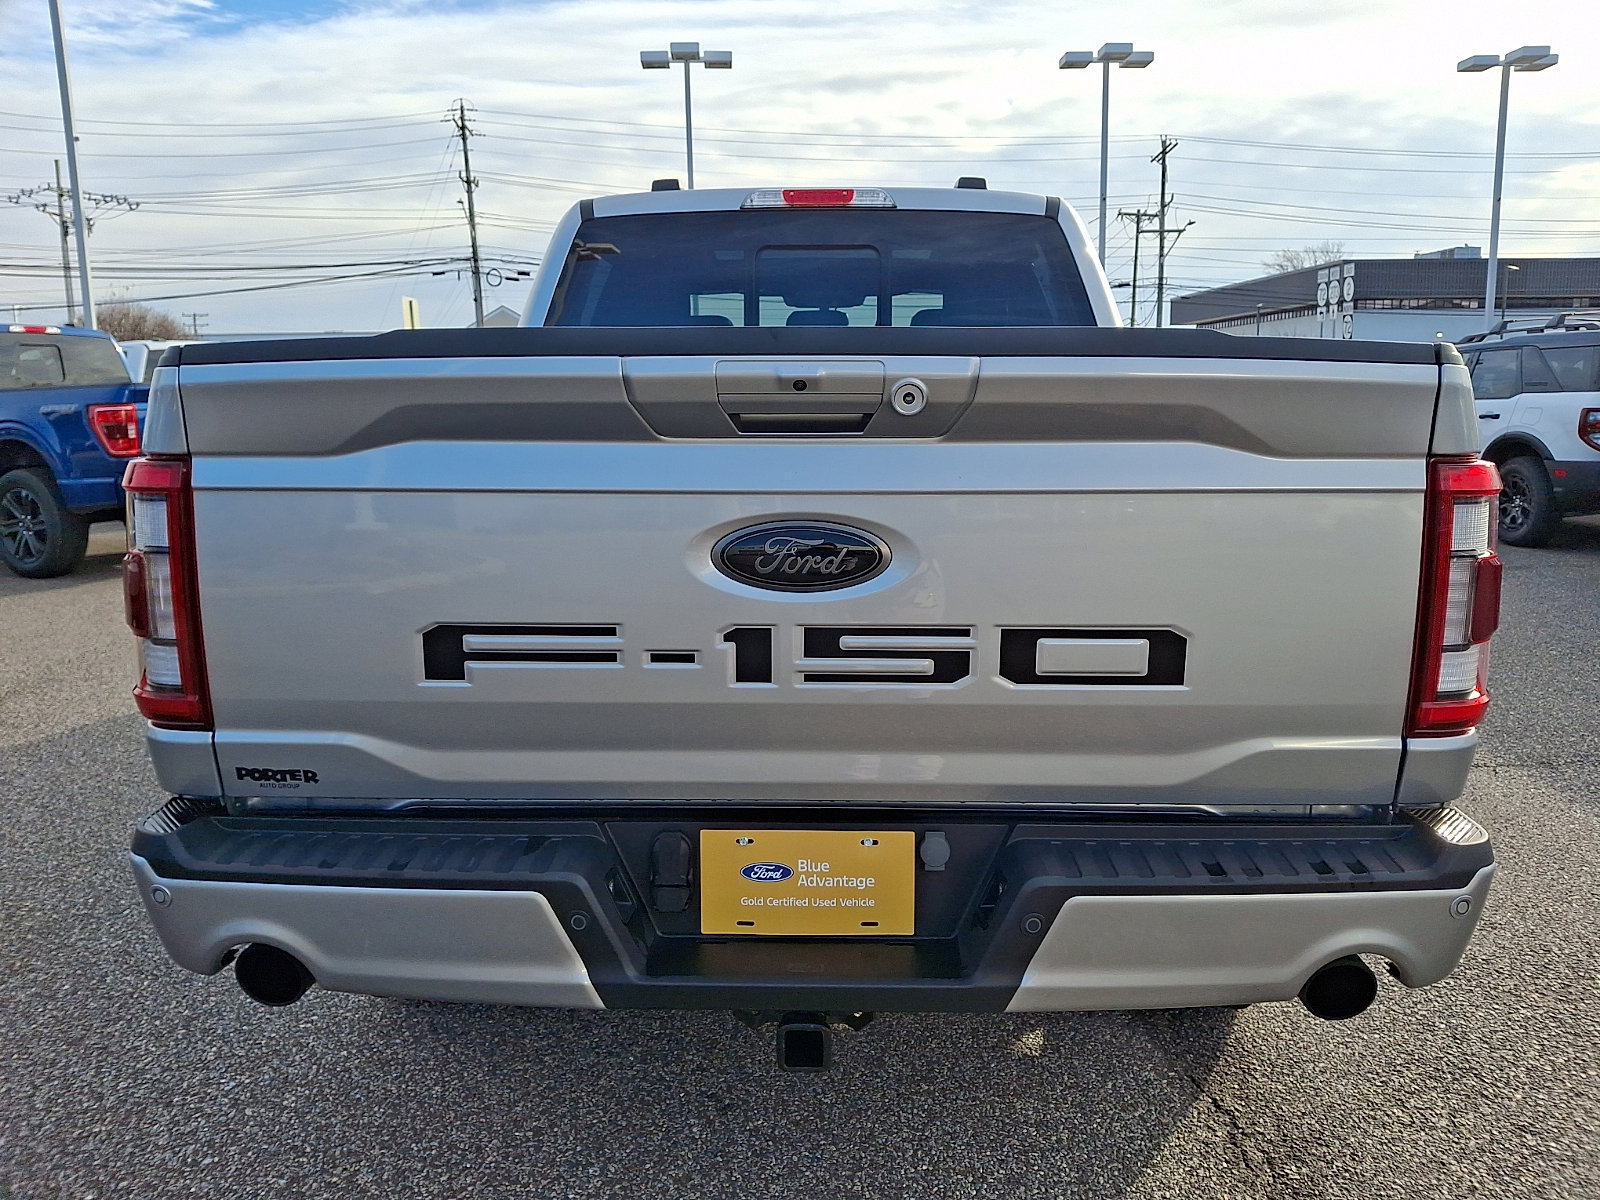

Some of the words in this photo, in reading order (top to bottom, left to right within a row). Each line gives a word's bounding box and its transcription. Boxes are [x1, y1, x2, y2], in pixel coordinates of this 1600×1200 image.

[754, 536, 849, 574] Ford
[420, 623, 1190, 687] F-150
[235, 766, 320, 784] PORTER
[751, 865, 783, 879] Ford
[797, 859, 830, 873] Blue
[797, 874, 875, 890] Advantage
[740, 896, 764, 906] Gold
[766, 896, 809, 907] Certified
[811, 897, 837, 907] Used
[840, 897, 875, 907] Vehicle
